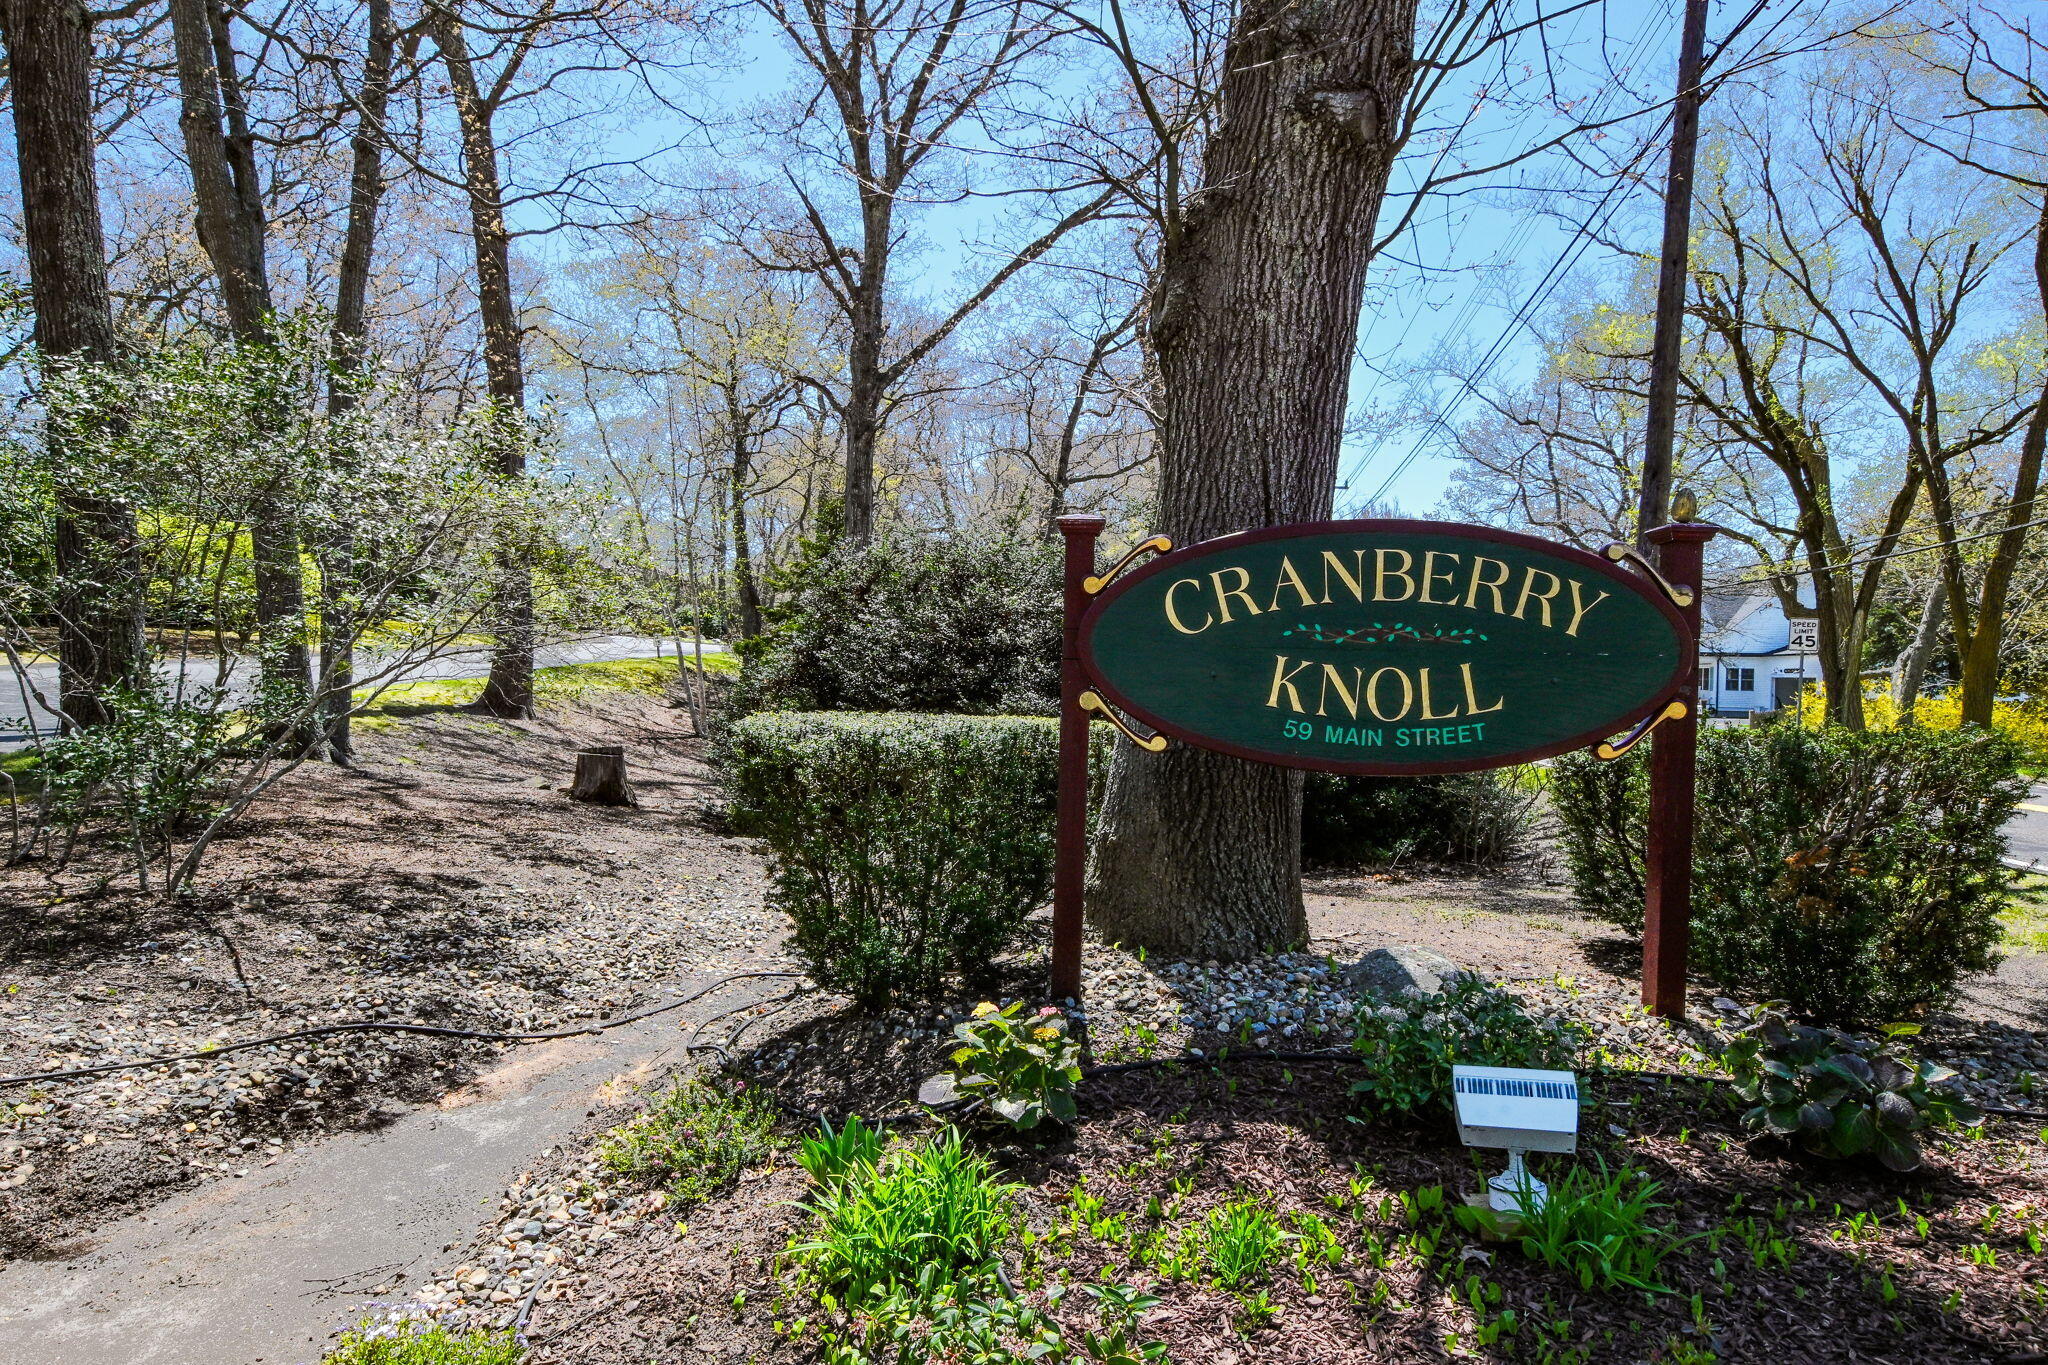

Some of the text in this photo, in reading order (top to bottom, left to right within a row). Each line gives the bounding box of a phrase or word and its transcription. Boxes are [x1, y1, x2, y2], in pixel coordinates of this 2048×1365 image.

[1164, 549, 1611, 637] CRANBERRY
[1791, 635, 1816, 648] 45
[1265, 654, 1504, 722] KNOLL
[1283, 719, 1486, 747] 59 MAIN STREET
